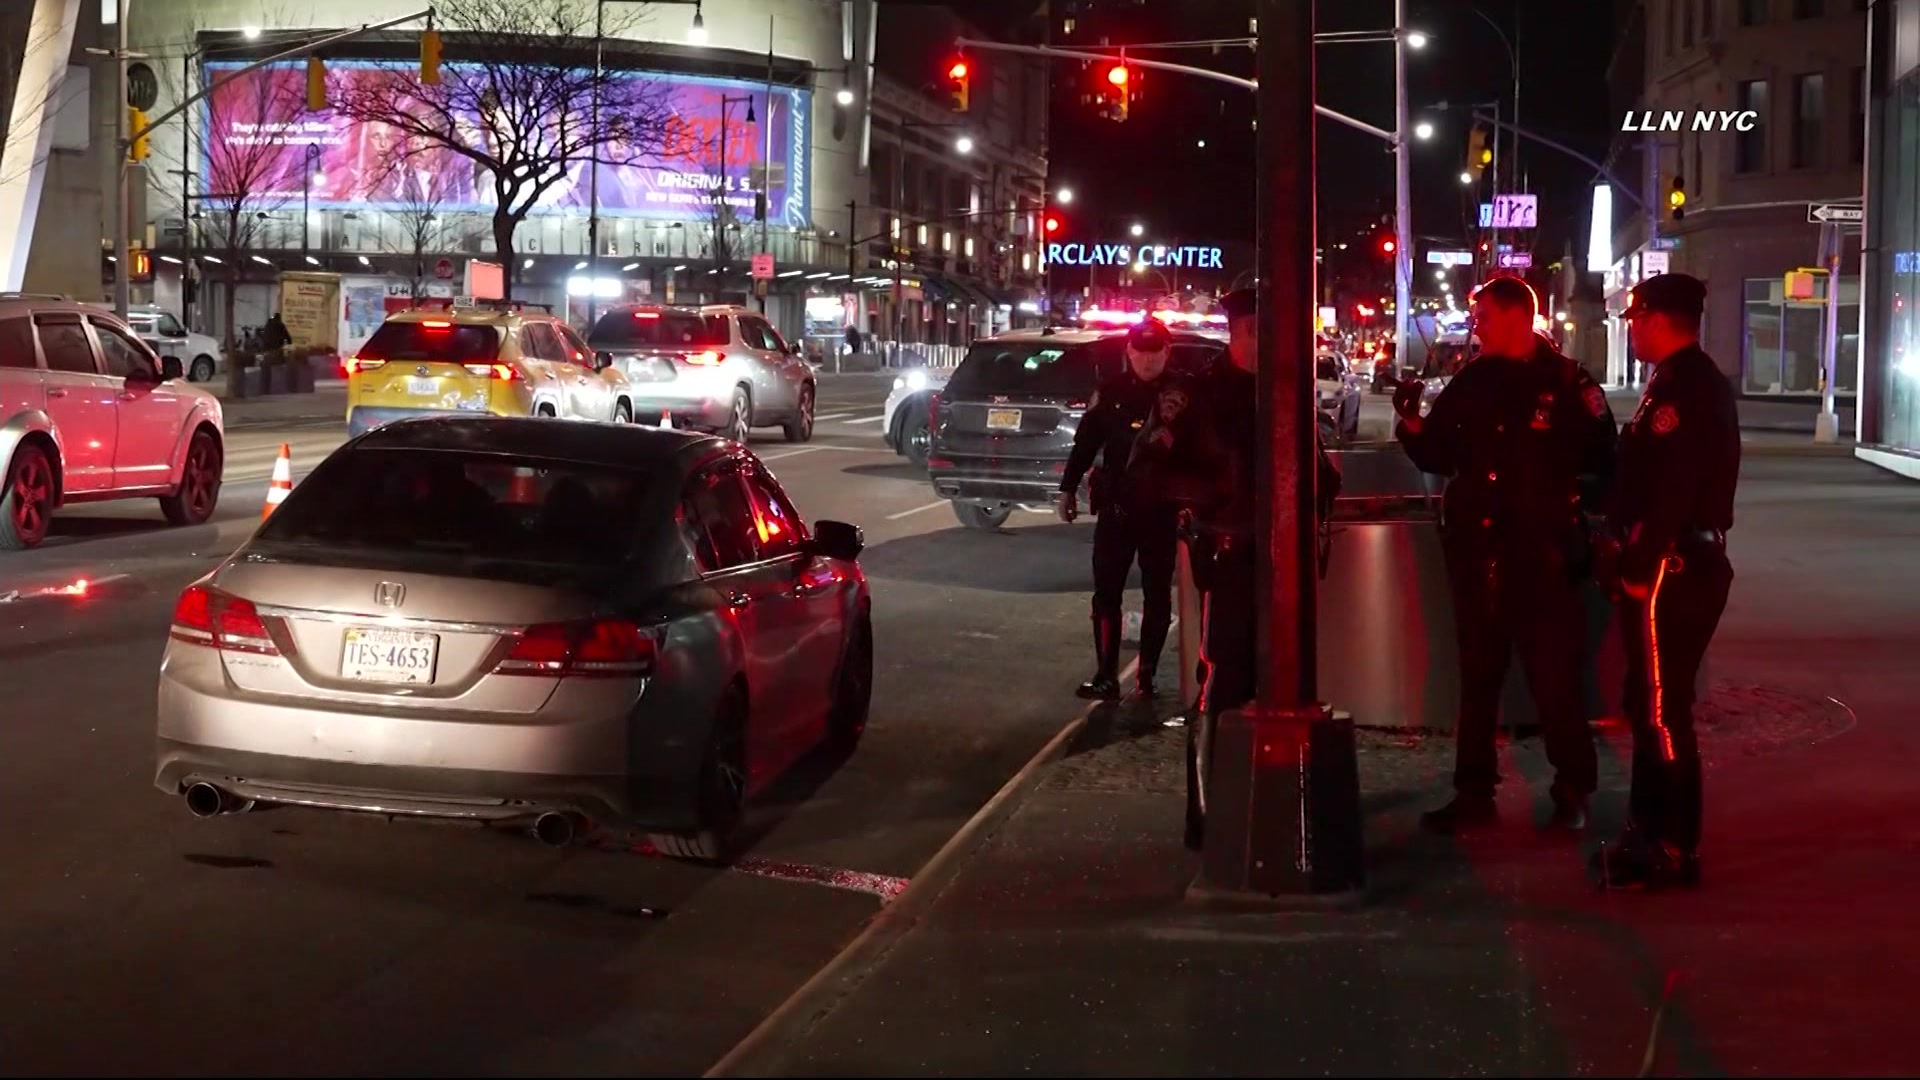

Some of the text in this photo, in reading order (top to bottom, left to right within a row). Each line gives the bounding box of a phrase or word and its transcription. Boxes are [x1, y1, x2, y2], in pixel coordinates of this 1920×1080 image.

[664, 116, 759, 165] DEXTER
[1138, 246, 1223, 268] CENTER
[349, 643, 430, 669] TES-4653
